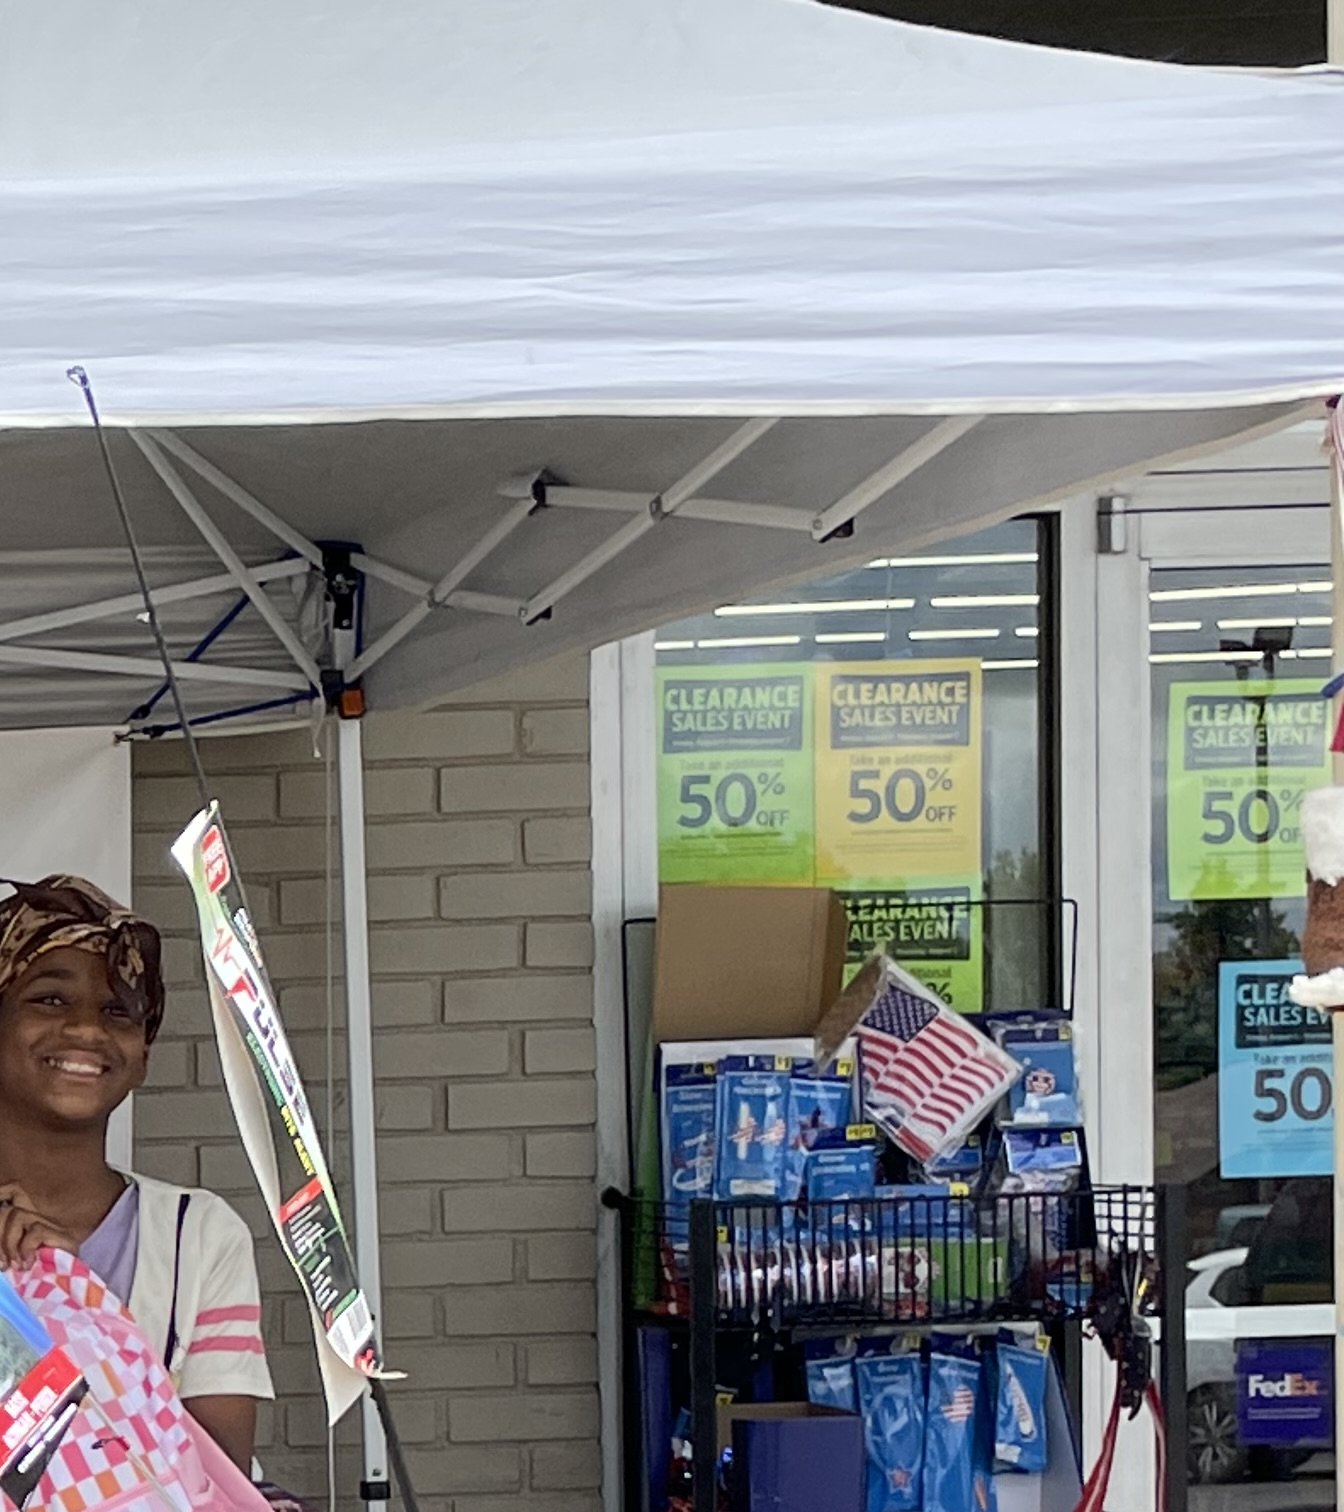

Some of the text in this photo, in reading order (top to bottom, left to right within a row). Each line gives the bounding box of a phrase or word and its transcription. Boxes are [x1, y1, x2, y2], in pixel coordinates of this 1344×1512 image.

[664, 685, 800, 711] CLEARANCE
[831, 681, 968, 706] CLEARANCE
[672, 708, 792, 732] SALES EVENT
[839, 704, 960, 728] SALES EVENT
[1187, 701, 1324, 727] CLEARANCE
[1192, 726, 1316, 748] SALES EVENT
[756, 809, 790, 827] OFF
[924, 805, 957, 822] OFF
[1279, 828, 1303, 844] OF
[840, 896, 969, 921] LEARANCE
[849, 919, 960, 942] ALES EVENT
[1243, 1006, 1302, 1026] SALES
[1248, 1372, 1320, 1398] FedEx
